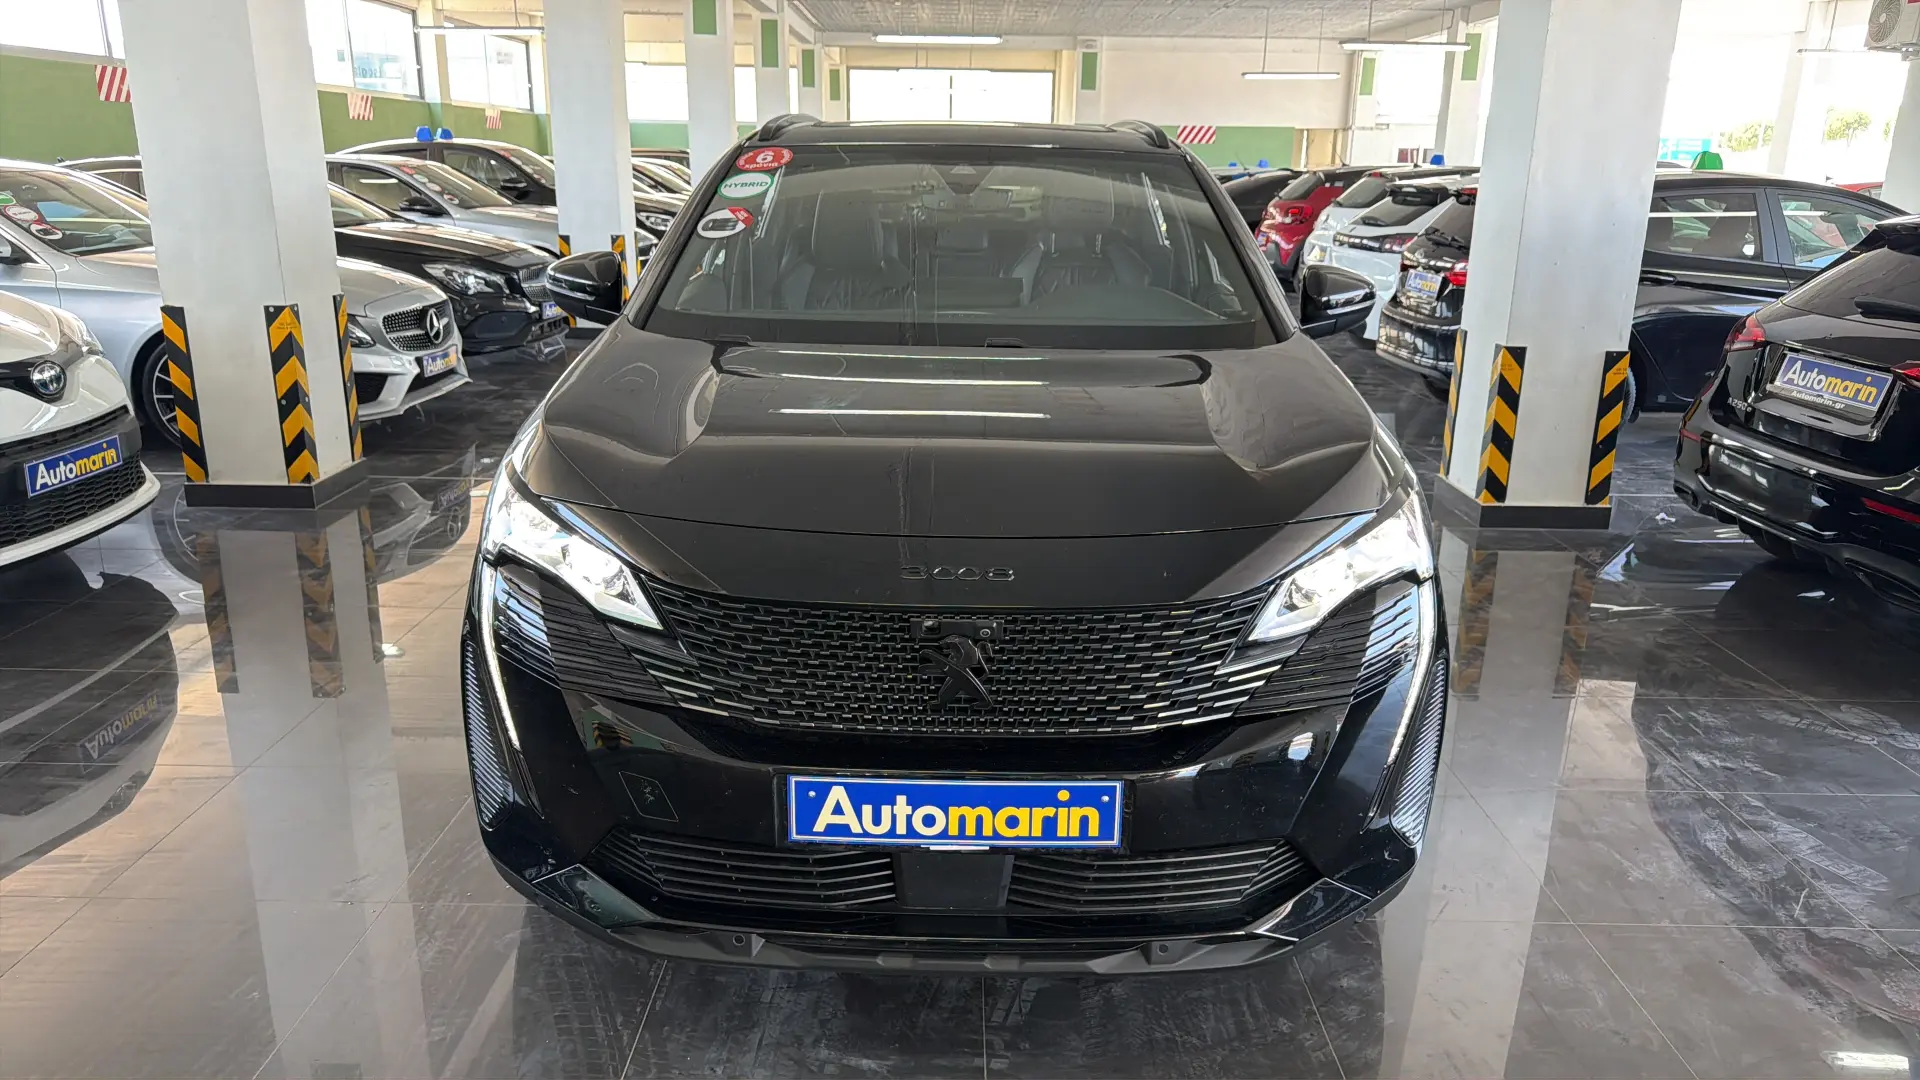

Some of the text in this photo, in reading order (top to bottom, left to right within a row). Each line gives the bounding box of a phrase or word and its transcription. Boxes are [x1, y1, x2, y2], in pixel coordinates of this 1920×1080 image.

[756, 150, 774, 163] 6
[723, 181, 769, 189] HYBRID
[1784, 360, 1878, 404] Automarin
[1791, 390, 1846, 409] Automarin.gr
[36, 443, 118, 490] Automarin
[900, 565, 1015, 581] 3008
[812, 785, 1100, 838] Automarin
